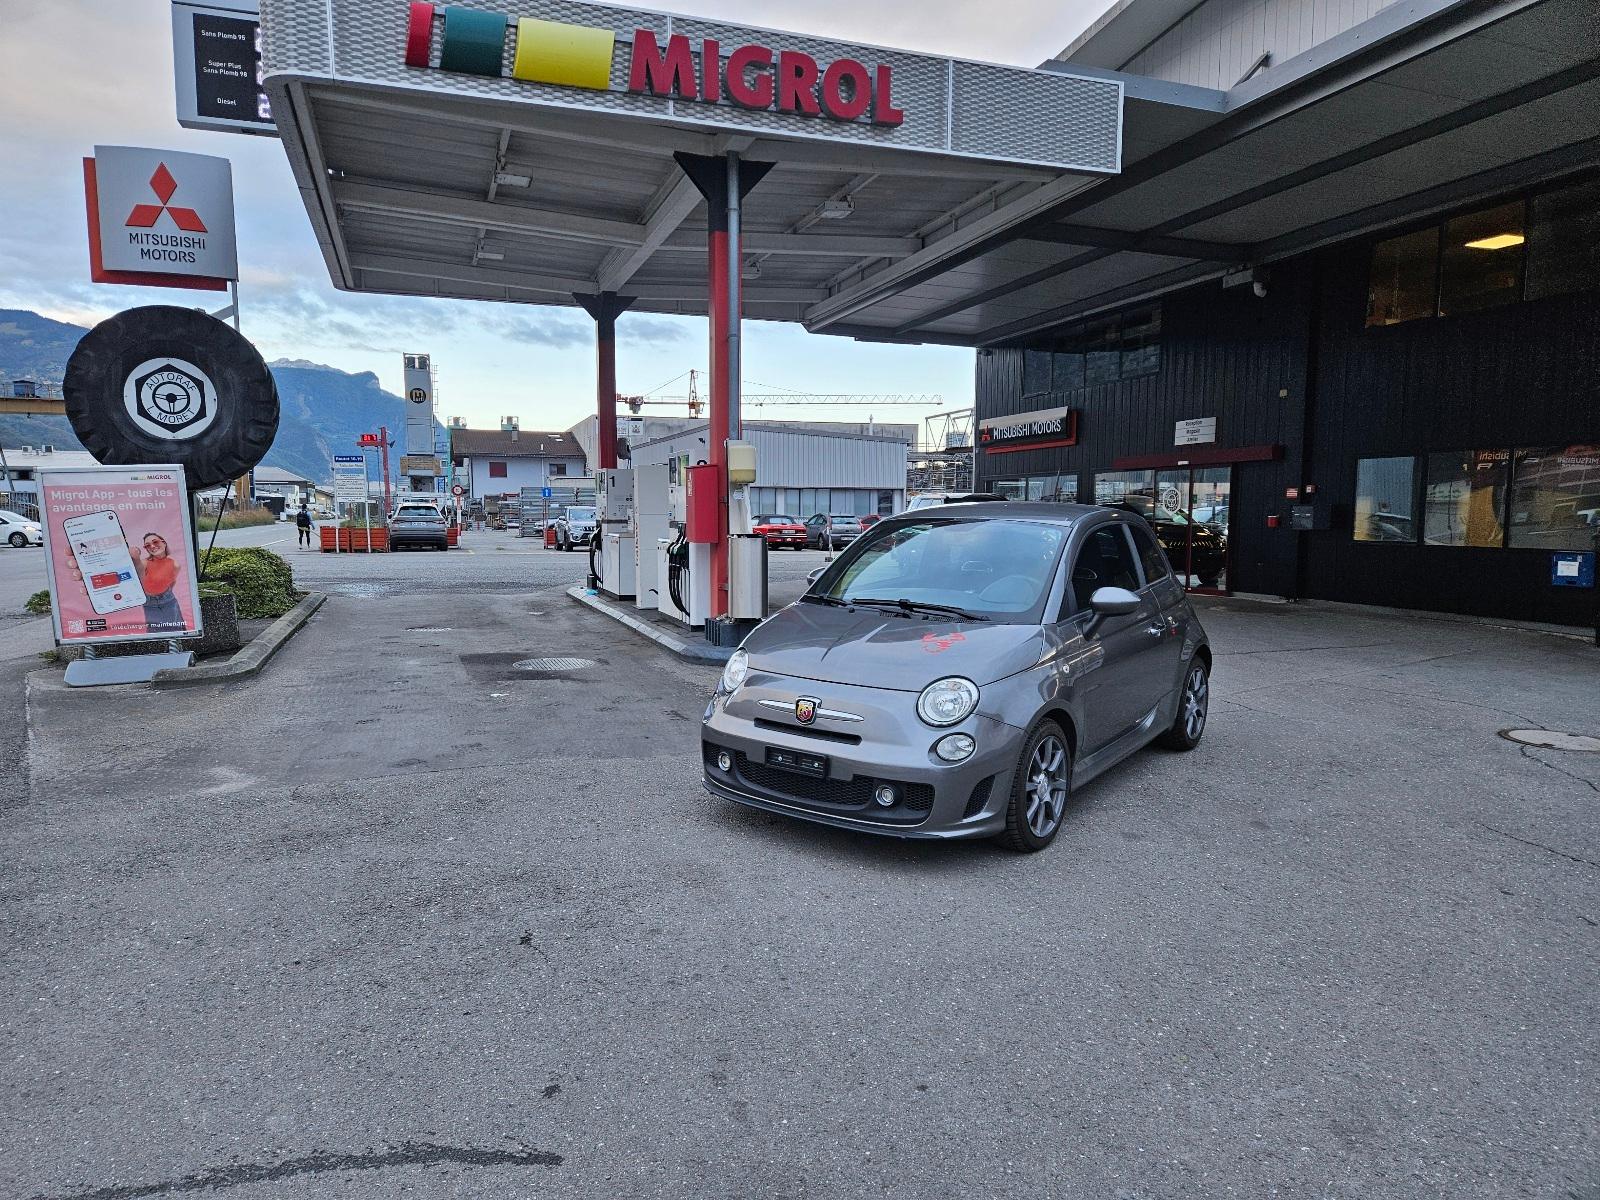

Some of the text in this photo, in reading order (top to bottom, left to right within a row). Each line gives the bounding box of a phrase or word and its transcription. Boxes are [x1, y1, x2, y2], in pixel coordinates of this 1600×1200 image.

[201, 29, 216, 37] Sans
[217, 31, 237, 40] Plomb
[208, 60, 226, 68] Super
[203, 66, 248, 78] Sans Plomb 98
[628, 28, 904, 128] MIGROL
[217, 97, 237, 106] Diesel
[129, 232, 206, 249] MITSUBISHI
[140, 248, 196, 263] MOTORS
[146, 372, 197, 392] AUTORAF
[156, 407, 195, 424] MORET
[993, 420, 1062, 440] MITSUBISHI MOTORS
[609, 475, 615, 488] 1
[51, 489, 90, 502] Migrol
[92, 490, 115, 500] App
[127, 488, 153, 499] tous
[155, 487, 173, 498] les
[52, 500, 166, 512] avantages en main
